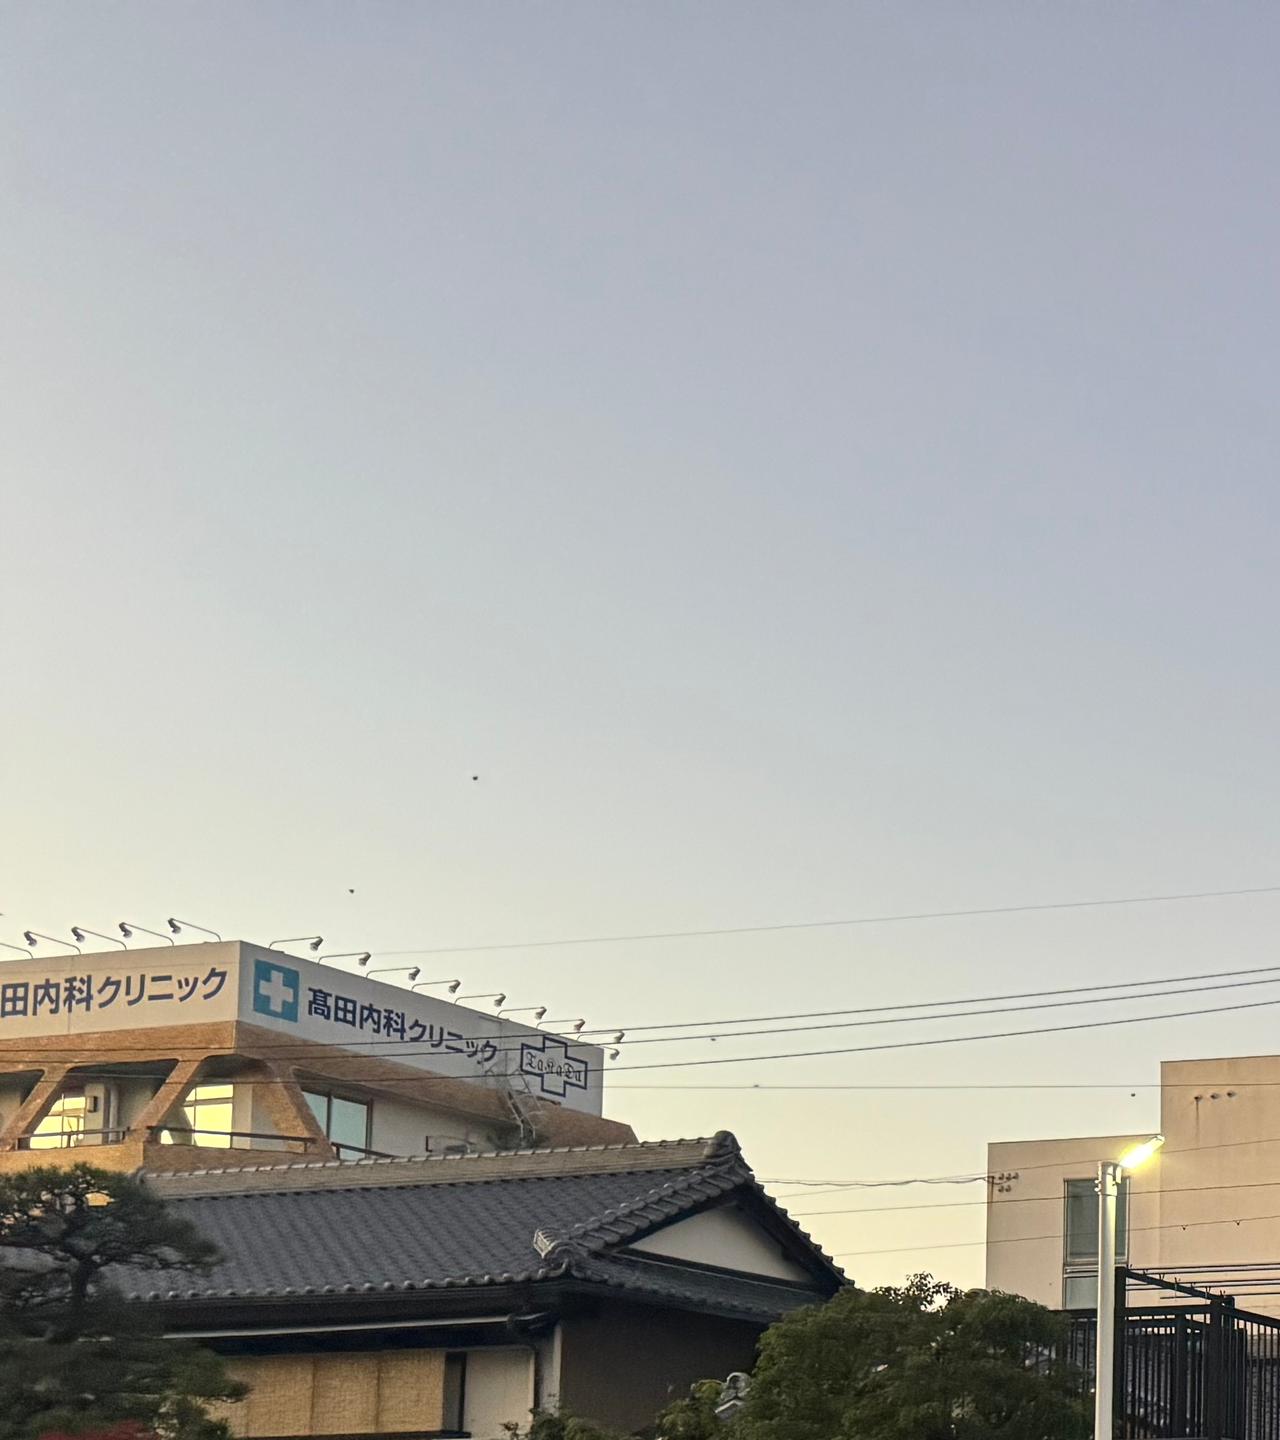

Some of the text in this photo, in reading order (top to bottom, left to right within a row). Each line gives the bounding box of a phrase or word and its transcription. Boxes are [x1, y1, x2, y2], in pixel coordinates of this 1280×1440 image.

[1, 967, 228, 1018] 田内科クリニック
